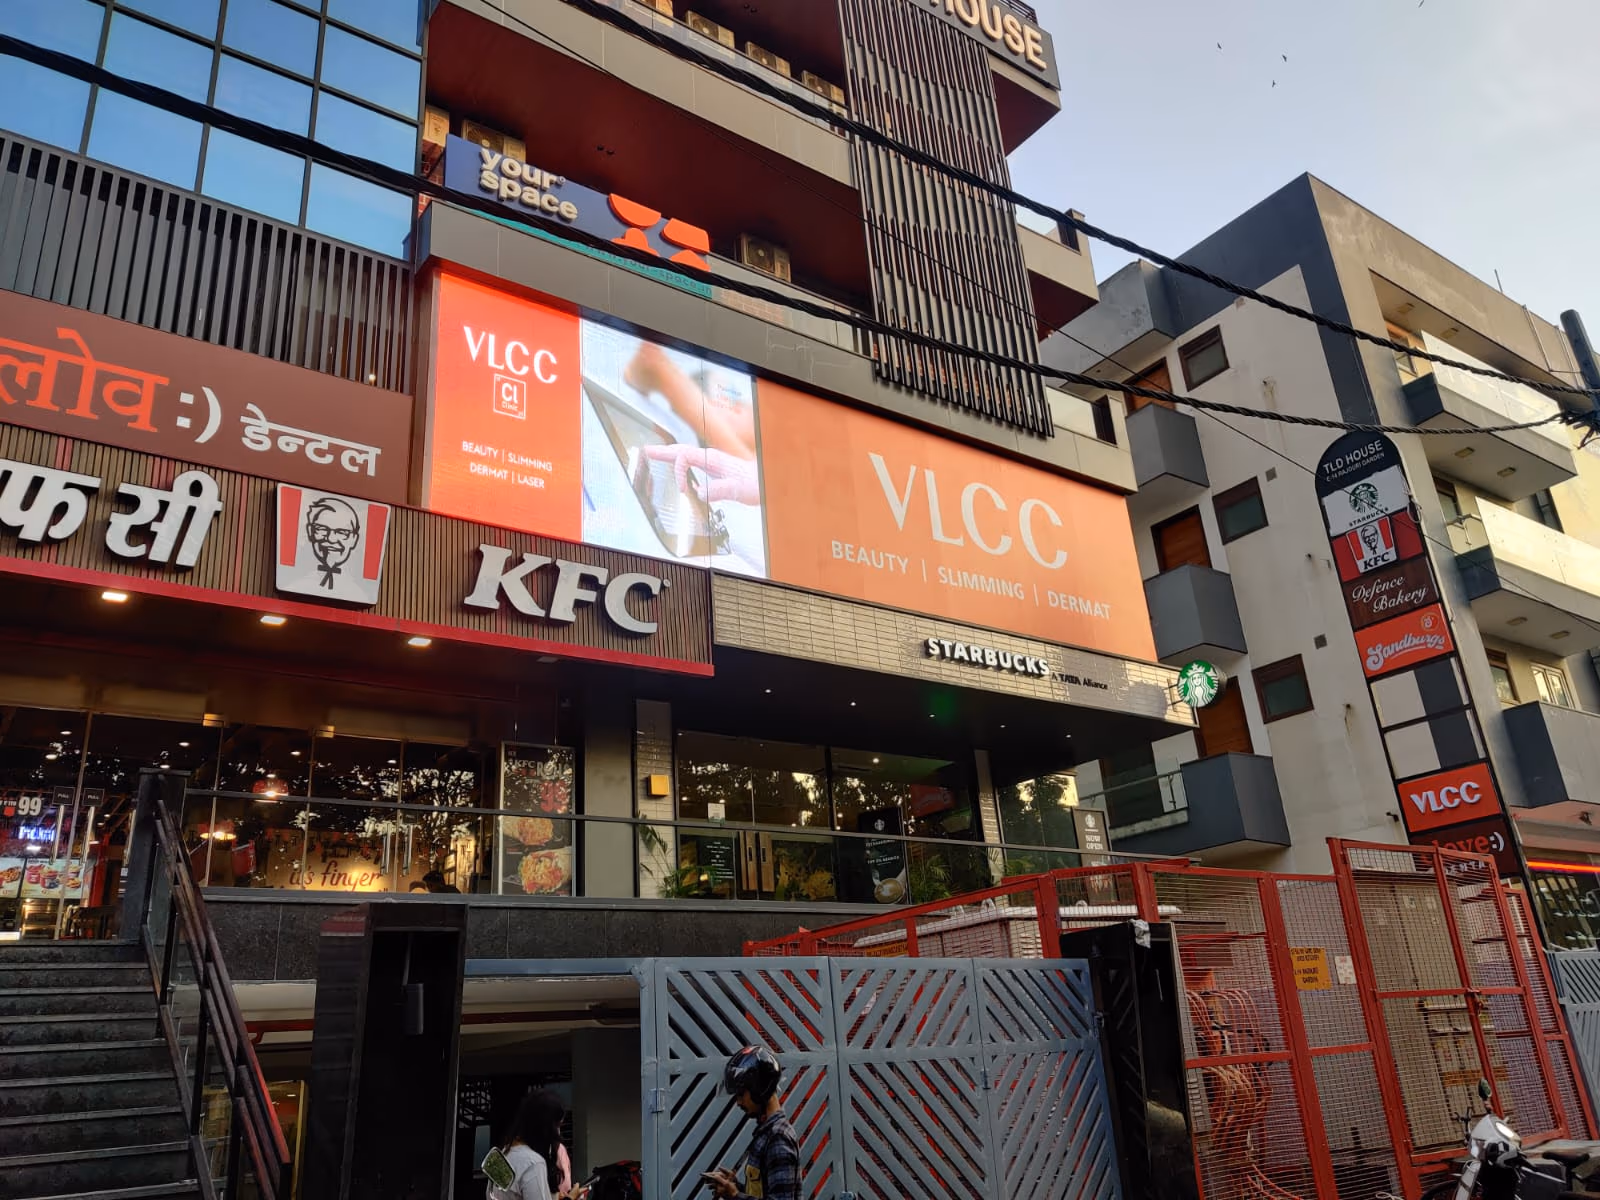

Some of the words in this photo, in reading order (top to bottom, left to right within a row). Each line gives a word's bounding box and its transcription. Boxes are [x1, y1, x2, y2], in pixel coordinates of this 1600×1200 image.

[930, 0, 1047, 70] OUSE
[480, 139, 558, 192] your
[480, 170, 578, 220] space
[463, 325, 558, 384] VLCC
[0, 327, 170, 432] लोव
[240, 403, 381, 476] डेन्टल
[462, 440, 499, 458] BEAUTY
[507, 452, 553, 472] SLIMMING
[1322, 457, 1344, 474] TLD
[1345, 440, 1383, 465] HOUSE
[470, 461, 508, 481] DERMAT
[517, 473, 545, 488] LASER
[868, 452, 1068, 570] VLCC
[1363, 551, 1390, 570] KFC
[464, 543, 662, 634] KFC
[831, 539, 909, 575] BEAUTY
[937, 565, 1025, 601] SLIMMING
[1047, 589, 1111, 620] DERMAT
[1352, 576, 1405, 603] Defence
[1373, 585, 1428, 613] Bakery
[926, 637, 1050, 676] STARBUCKS
[514, 759, 537, 769] KFC
[18, 796, 42, 816] 99
[1409, 781, 1483, 815] VLCC
[1085, 834, 1101, 842] NOW
[1085, 842, 1104, 850] OPEN
